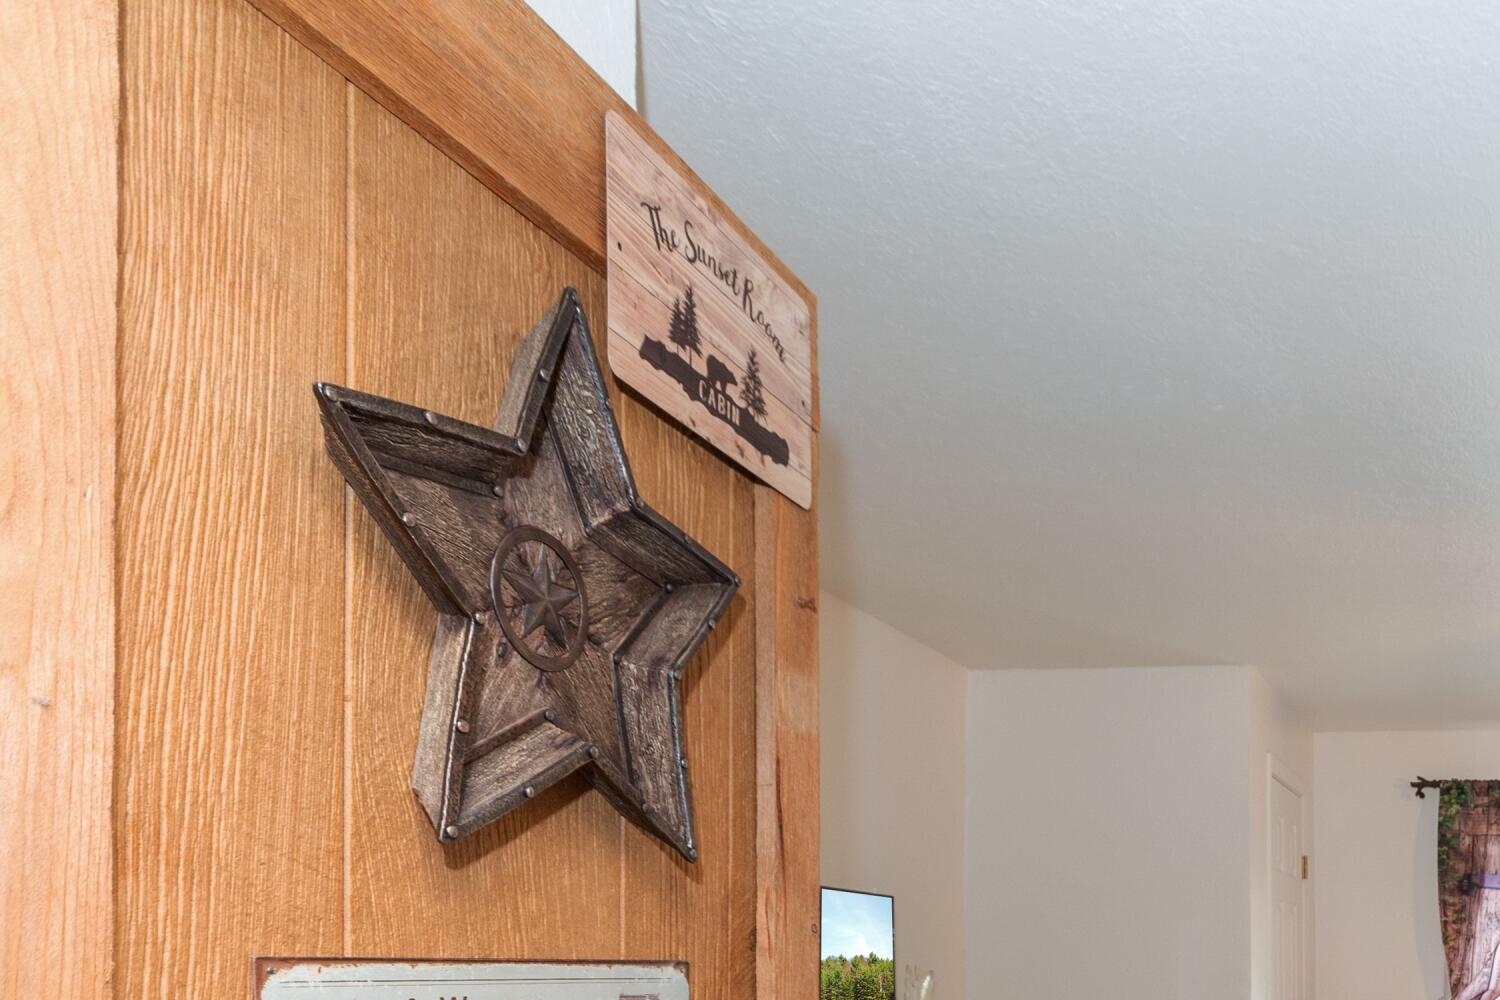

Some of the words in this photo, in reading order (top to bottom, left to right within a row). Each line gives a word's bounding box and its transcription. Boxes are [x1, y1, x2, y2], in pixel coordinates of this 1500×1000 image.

[641, 202, 680, 252] The
[684, 220, 740, 296] Sunset
[742, 277, 786, 364] Room
[699, 380, 740, 427] CABIN
